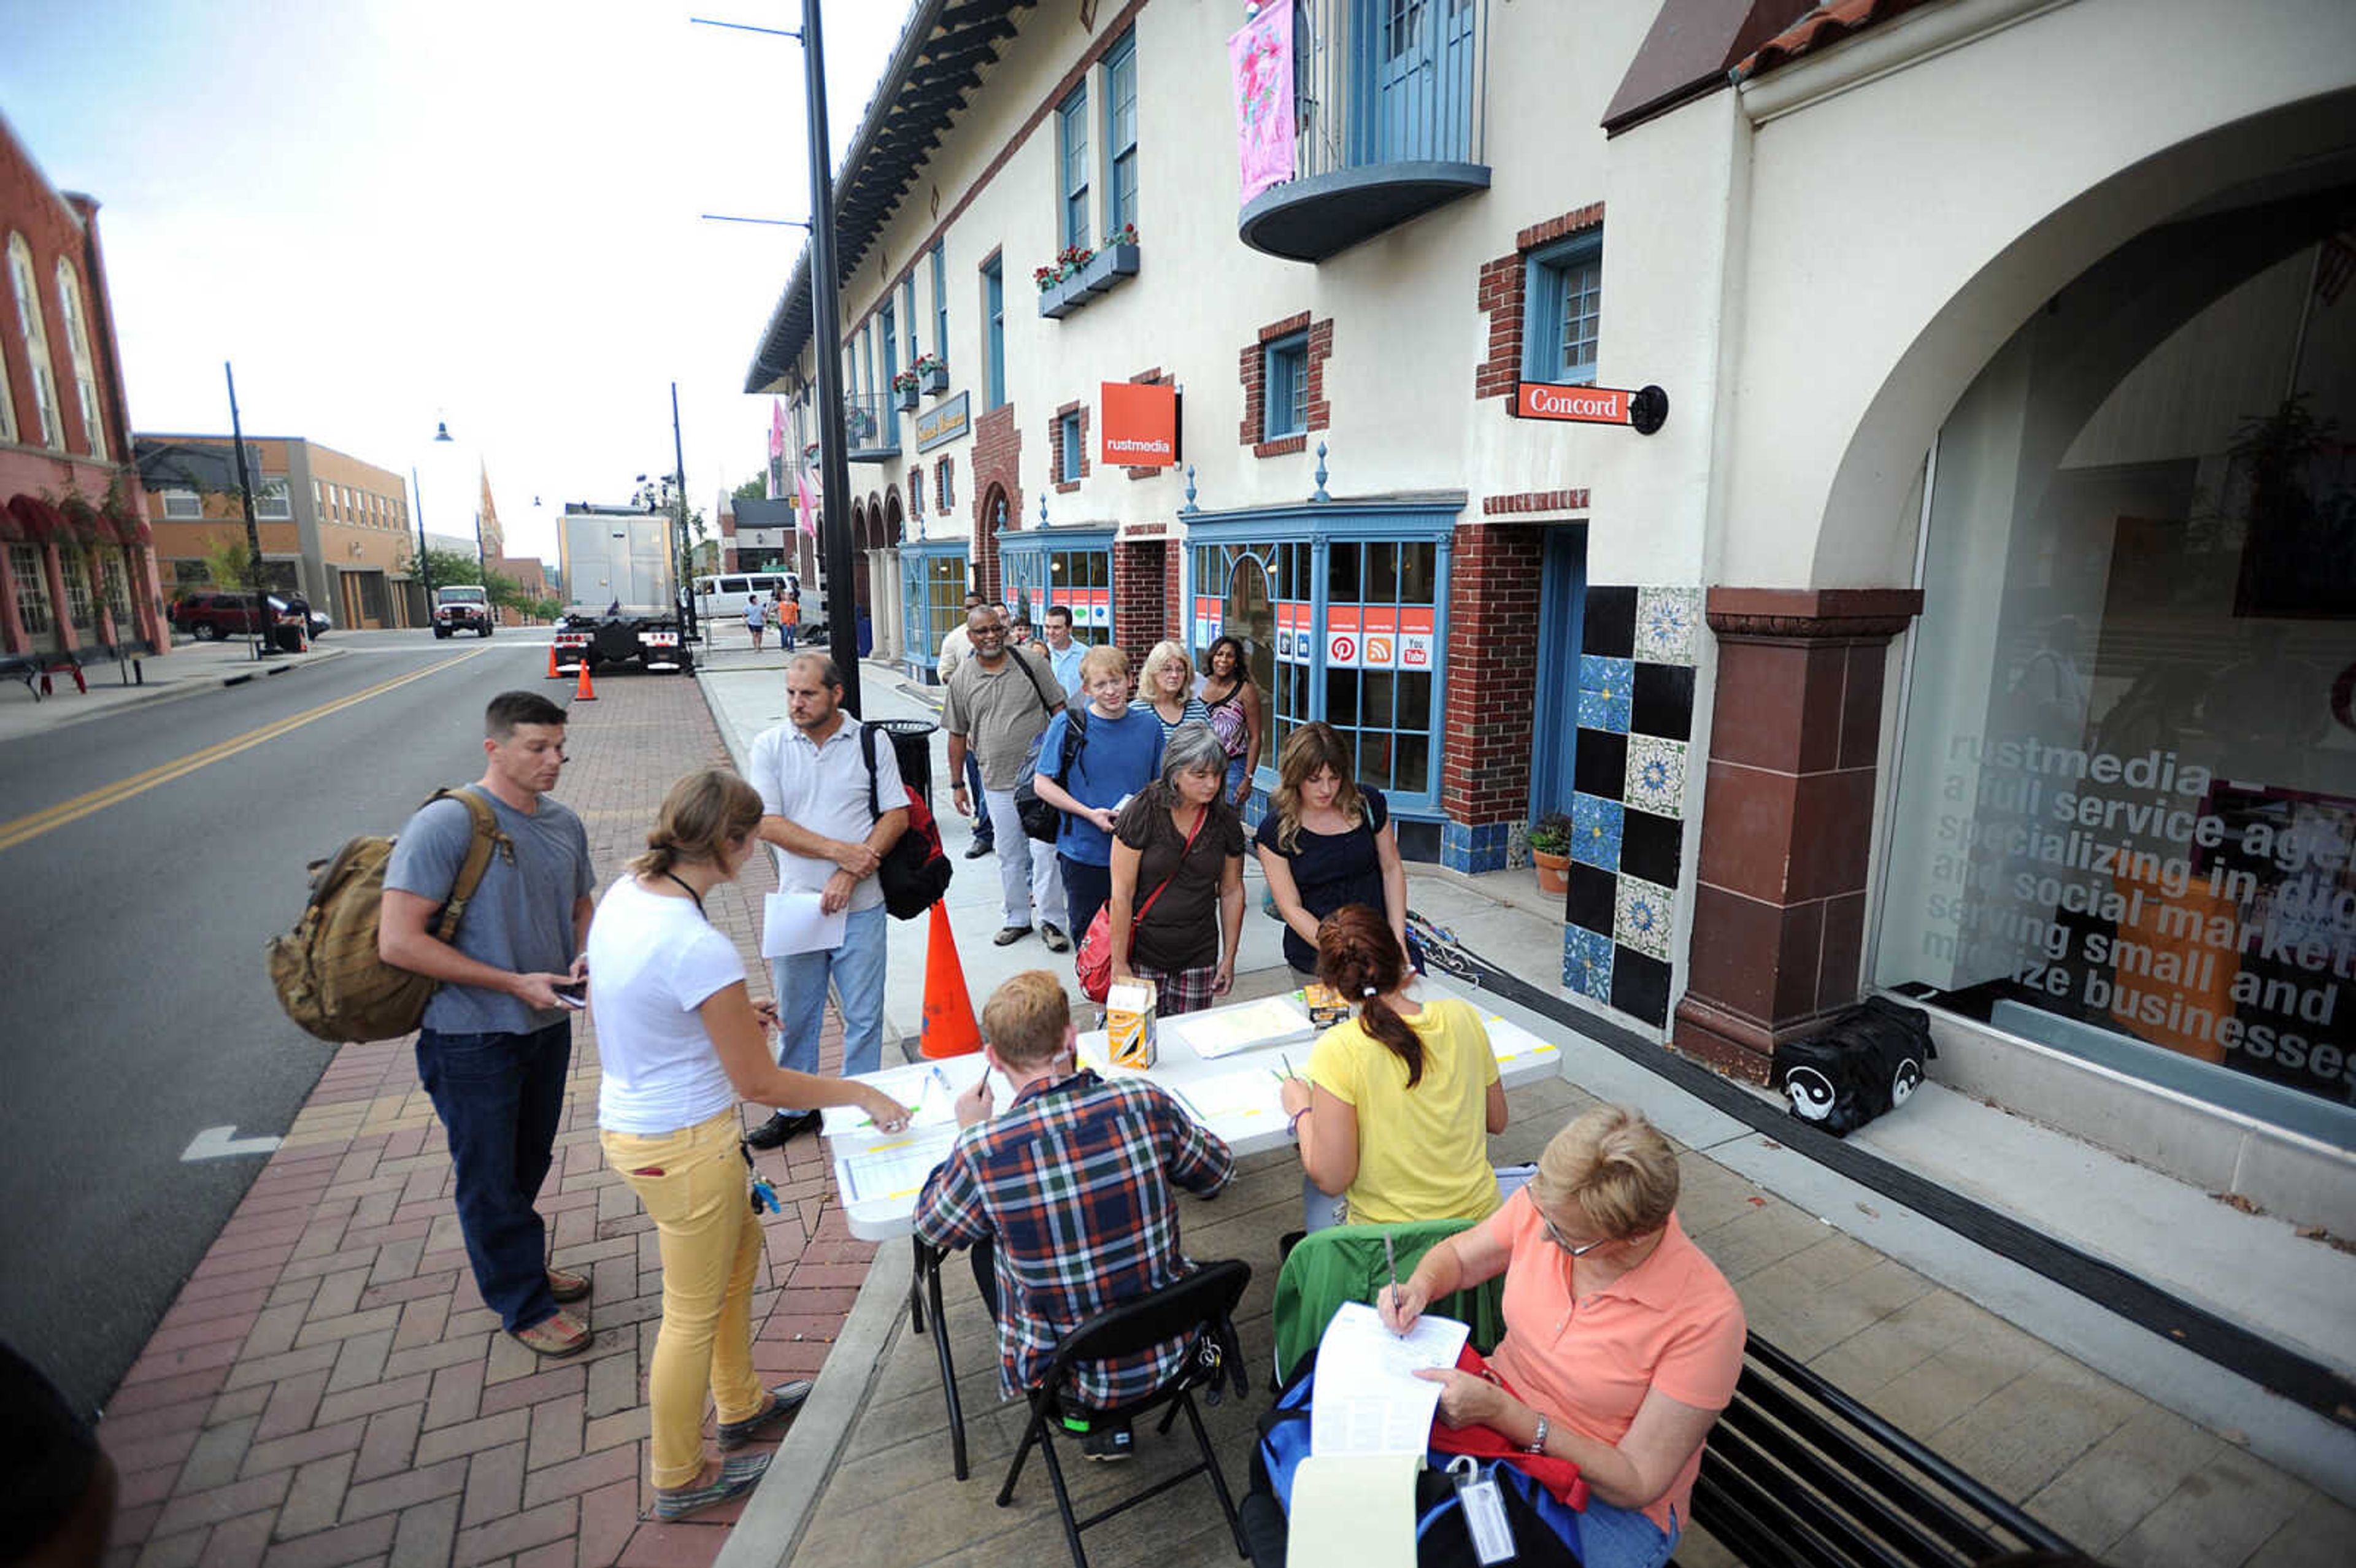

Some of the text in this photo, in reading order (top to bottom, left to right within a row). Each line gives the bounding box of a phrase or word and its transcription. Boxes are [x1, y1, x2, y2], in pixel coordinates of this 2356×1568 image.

[1107, 438, 1171, 453] rustmedia
[1530, 388, 1618, 417] Concord
[1950, 736, 2210, 796] rustmedia
[1932, 815, 2191, 898] specializing
[2211, 858, 2257, 904] in
[1979, 774, 2041, 815] full
[2054, 790, 2225, 847] service
[2241, 822, 2356, 872] age
[1929, 894, 2337, 1026] serving small and
[2015, 872, 2143, 928] social
[2158, 905, 2356, 980] market
